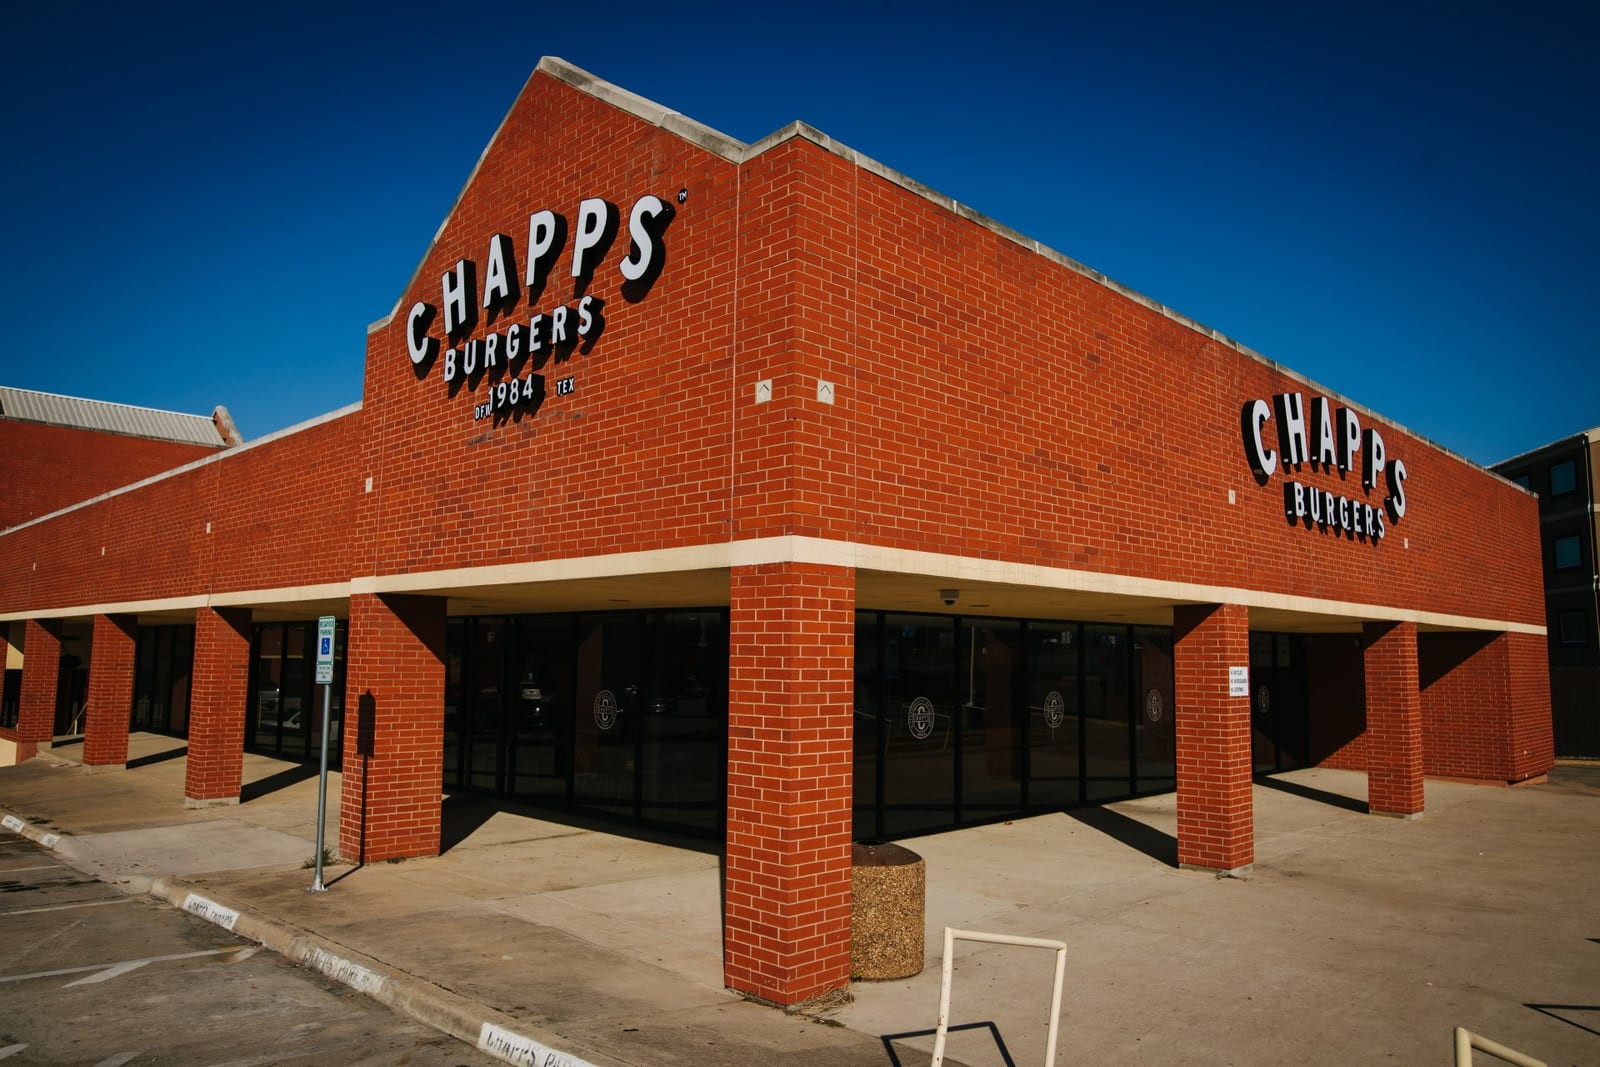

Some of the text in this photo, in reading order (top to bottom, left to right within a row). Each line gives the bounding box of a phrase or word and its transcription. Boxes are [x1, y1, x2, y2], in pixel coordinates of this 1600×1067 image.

[406, 194, 664, 365] CHAPPS
[443, 295, 593, 383] BURGERS
[488, 373, 533, 411] 1984
[556, 376, 575, 397] TEX
[1251, 391, 1408, 519] CHAPPS
[1293, 480, 1386, 540] BURGERS
